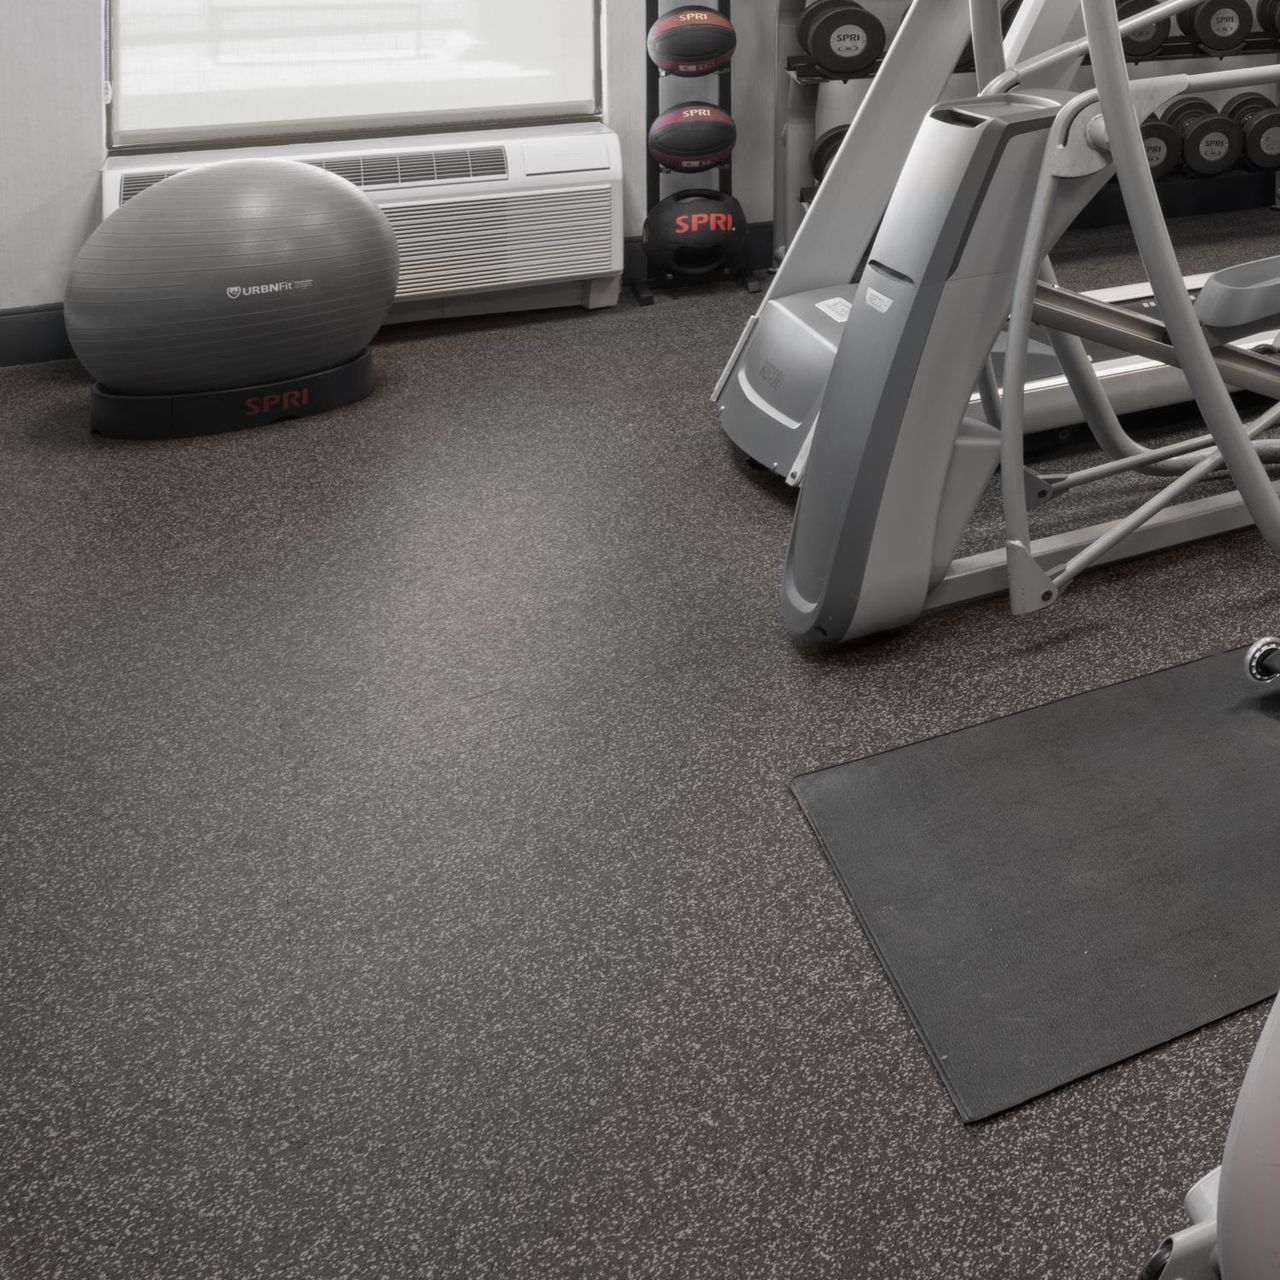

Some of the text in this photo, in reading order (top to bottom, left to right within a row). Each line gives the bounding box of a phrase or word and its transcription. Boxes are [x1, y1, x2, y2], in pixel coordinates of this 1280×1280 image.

[678, 12, 708, 23] SPRI
[1215, 16, 1234, 25] SPRI
[836, 33, 860, 42] SPRI
[682, 108, 711, 118] SPRI
[1204, 139, 1224, 148] SPRI
[242, 282, 293, 296] URBNFit
[244, 387, 310, 417] SPRI
